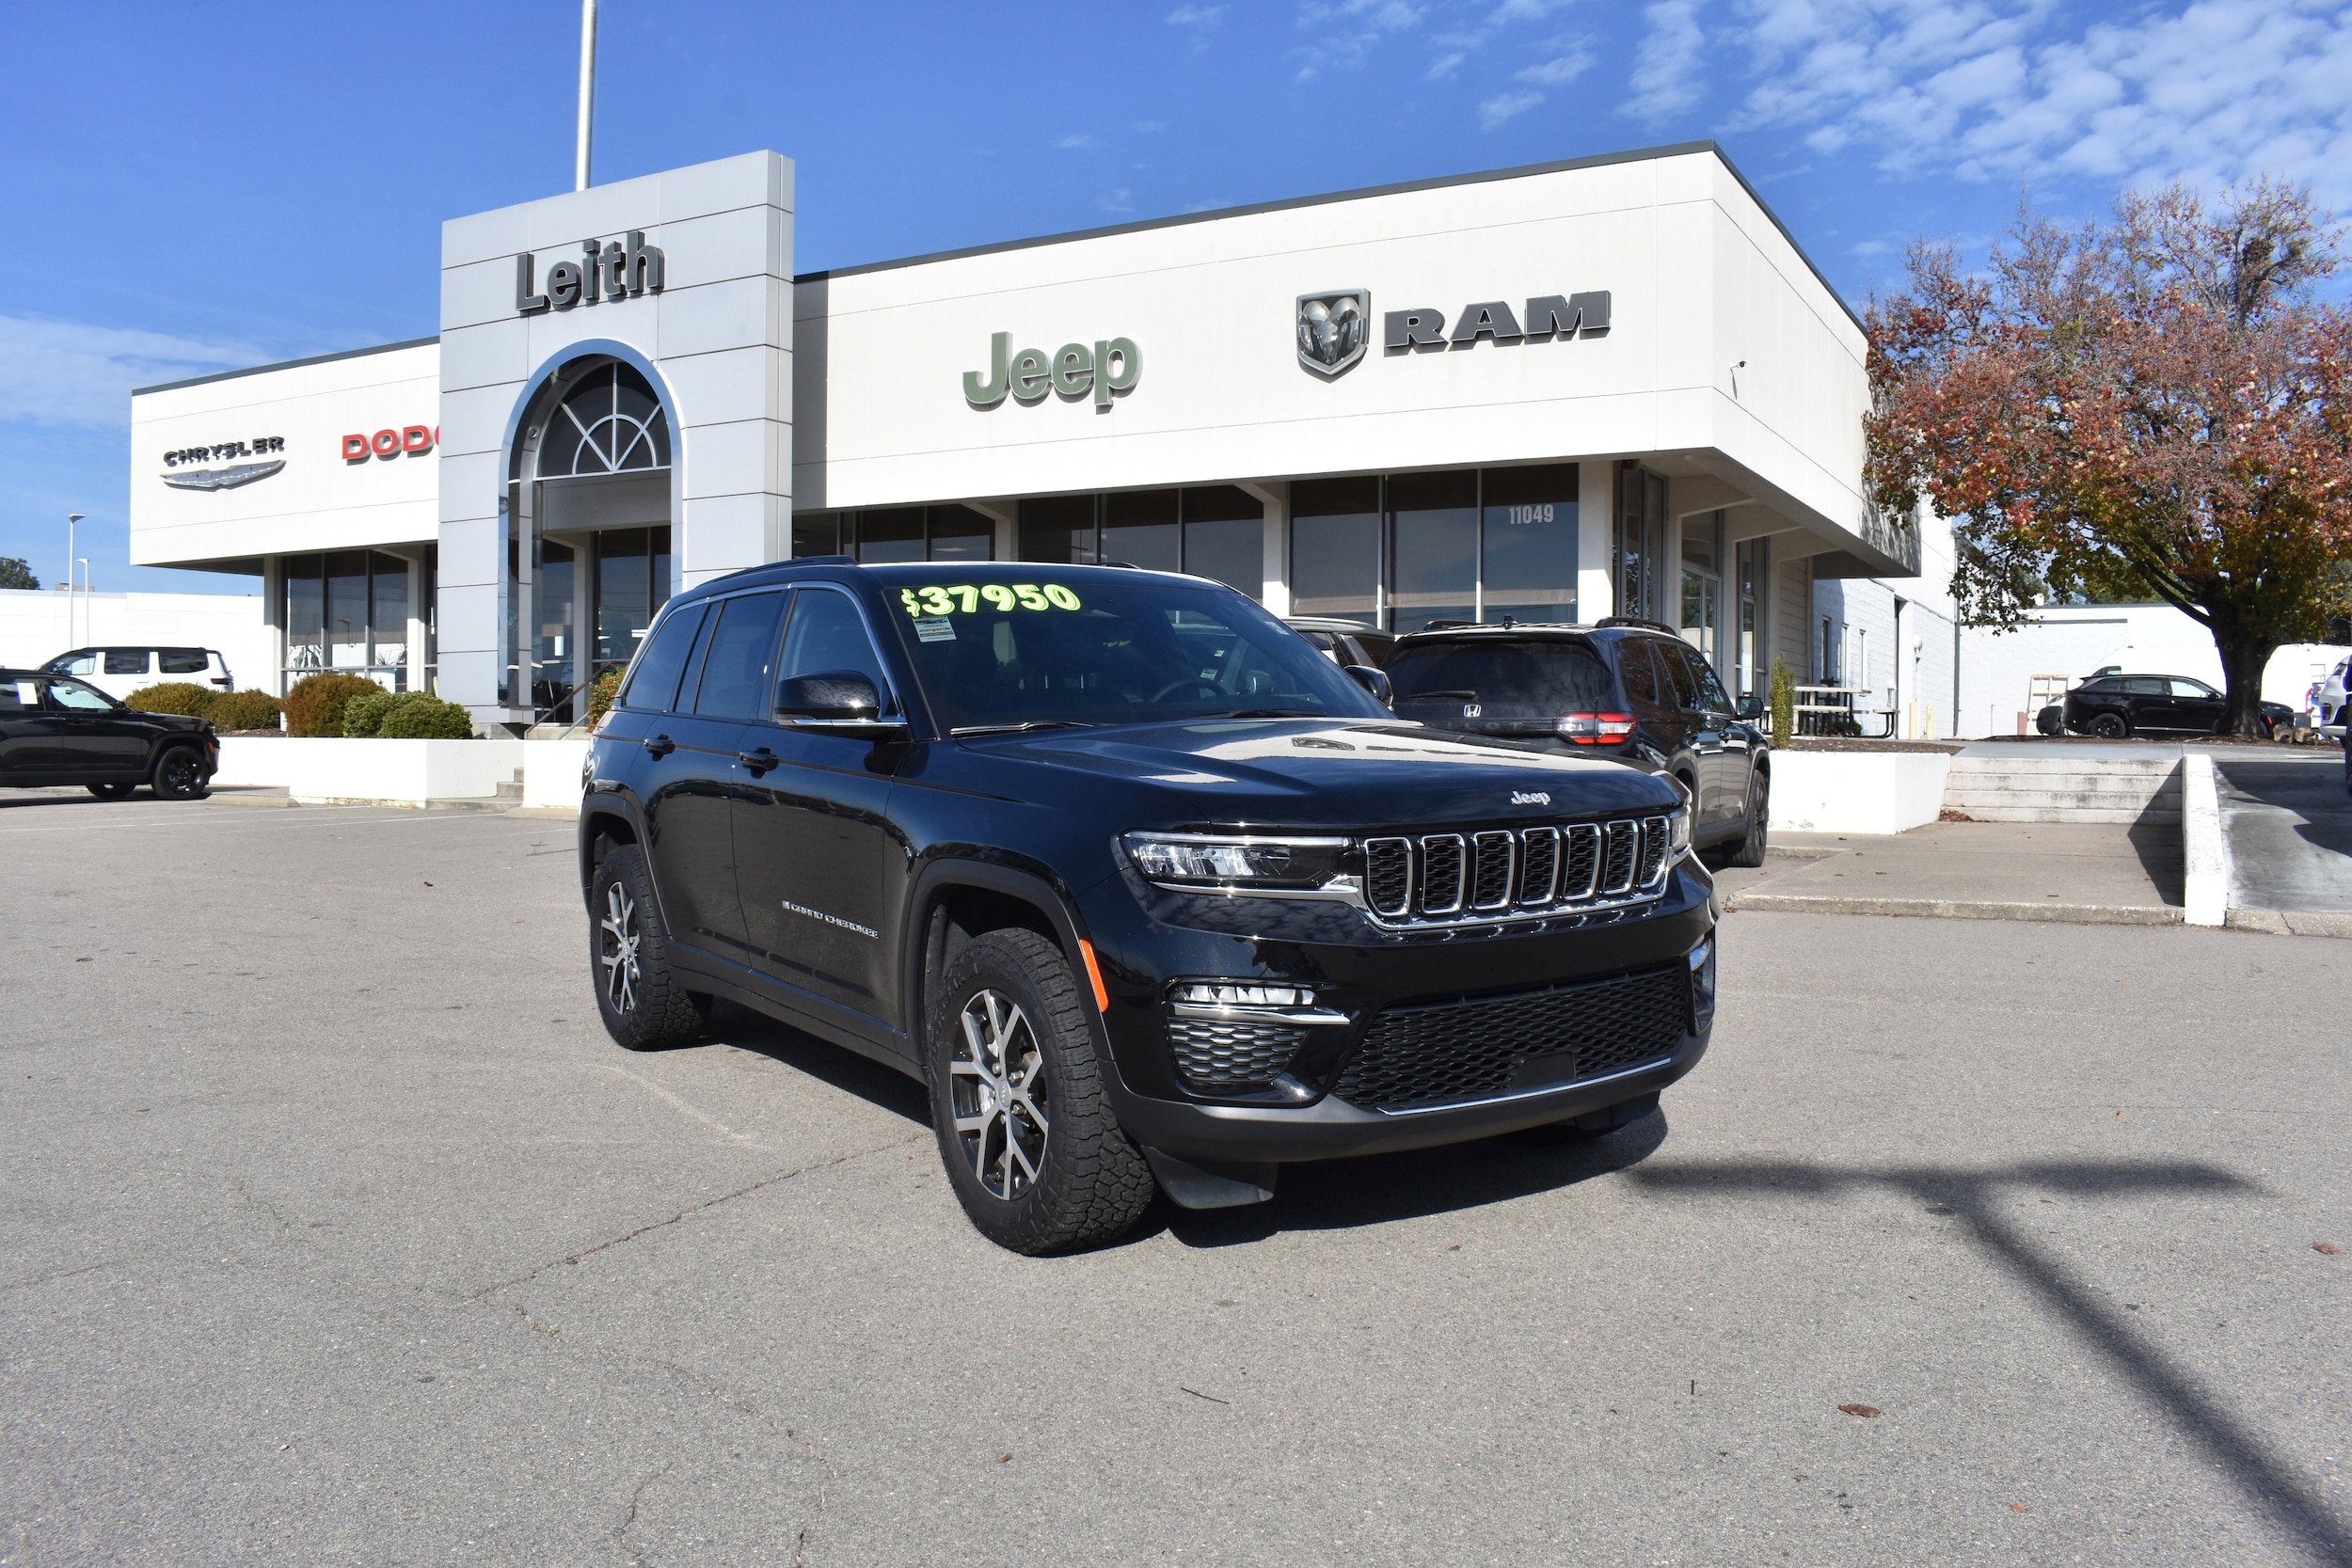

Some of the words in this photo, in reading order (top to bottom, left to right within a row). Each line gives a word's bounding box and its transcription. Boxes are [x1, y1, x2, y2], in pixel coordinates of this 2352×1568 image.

[516, 230, 665, 312] Leith
[1384, 290, 1613, 350] RAM
[961, 331, 1142, 410] Jeep
[163, 436, 285, 467] CHRYSLER
[342, 424, 439, 466] DOD
[1509, 504, 1554, 524] 11049
[900, 583, 1082, 618] $37950
[1510, 790, 1551, 806] Jeep
[791, 903, 823, 919] GRAND
[825, 914, 880, 940] CHEROKEE
